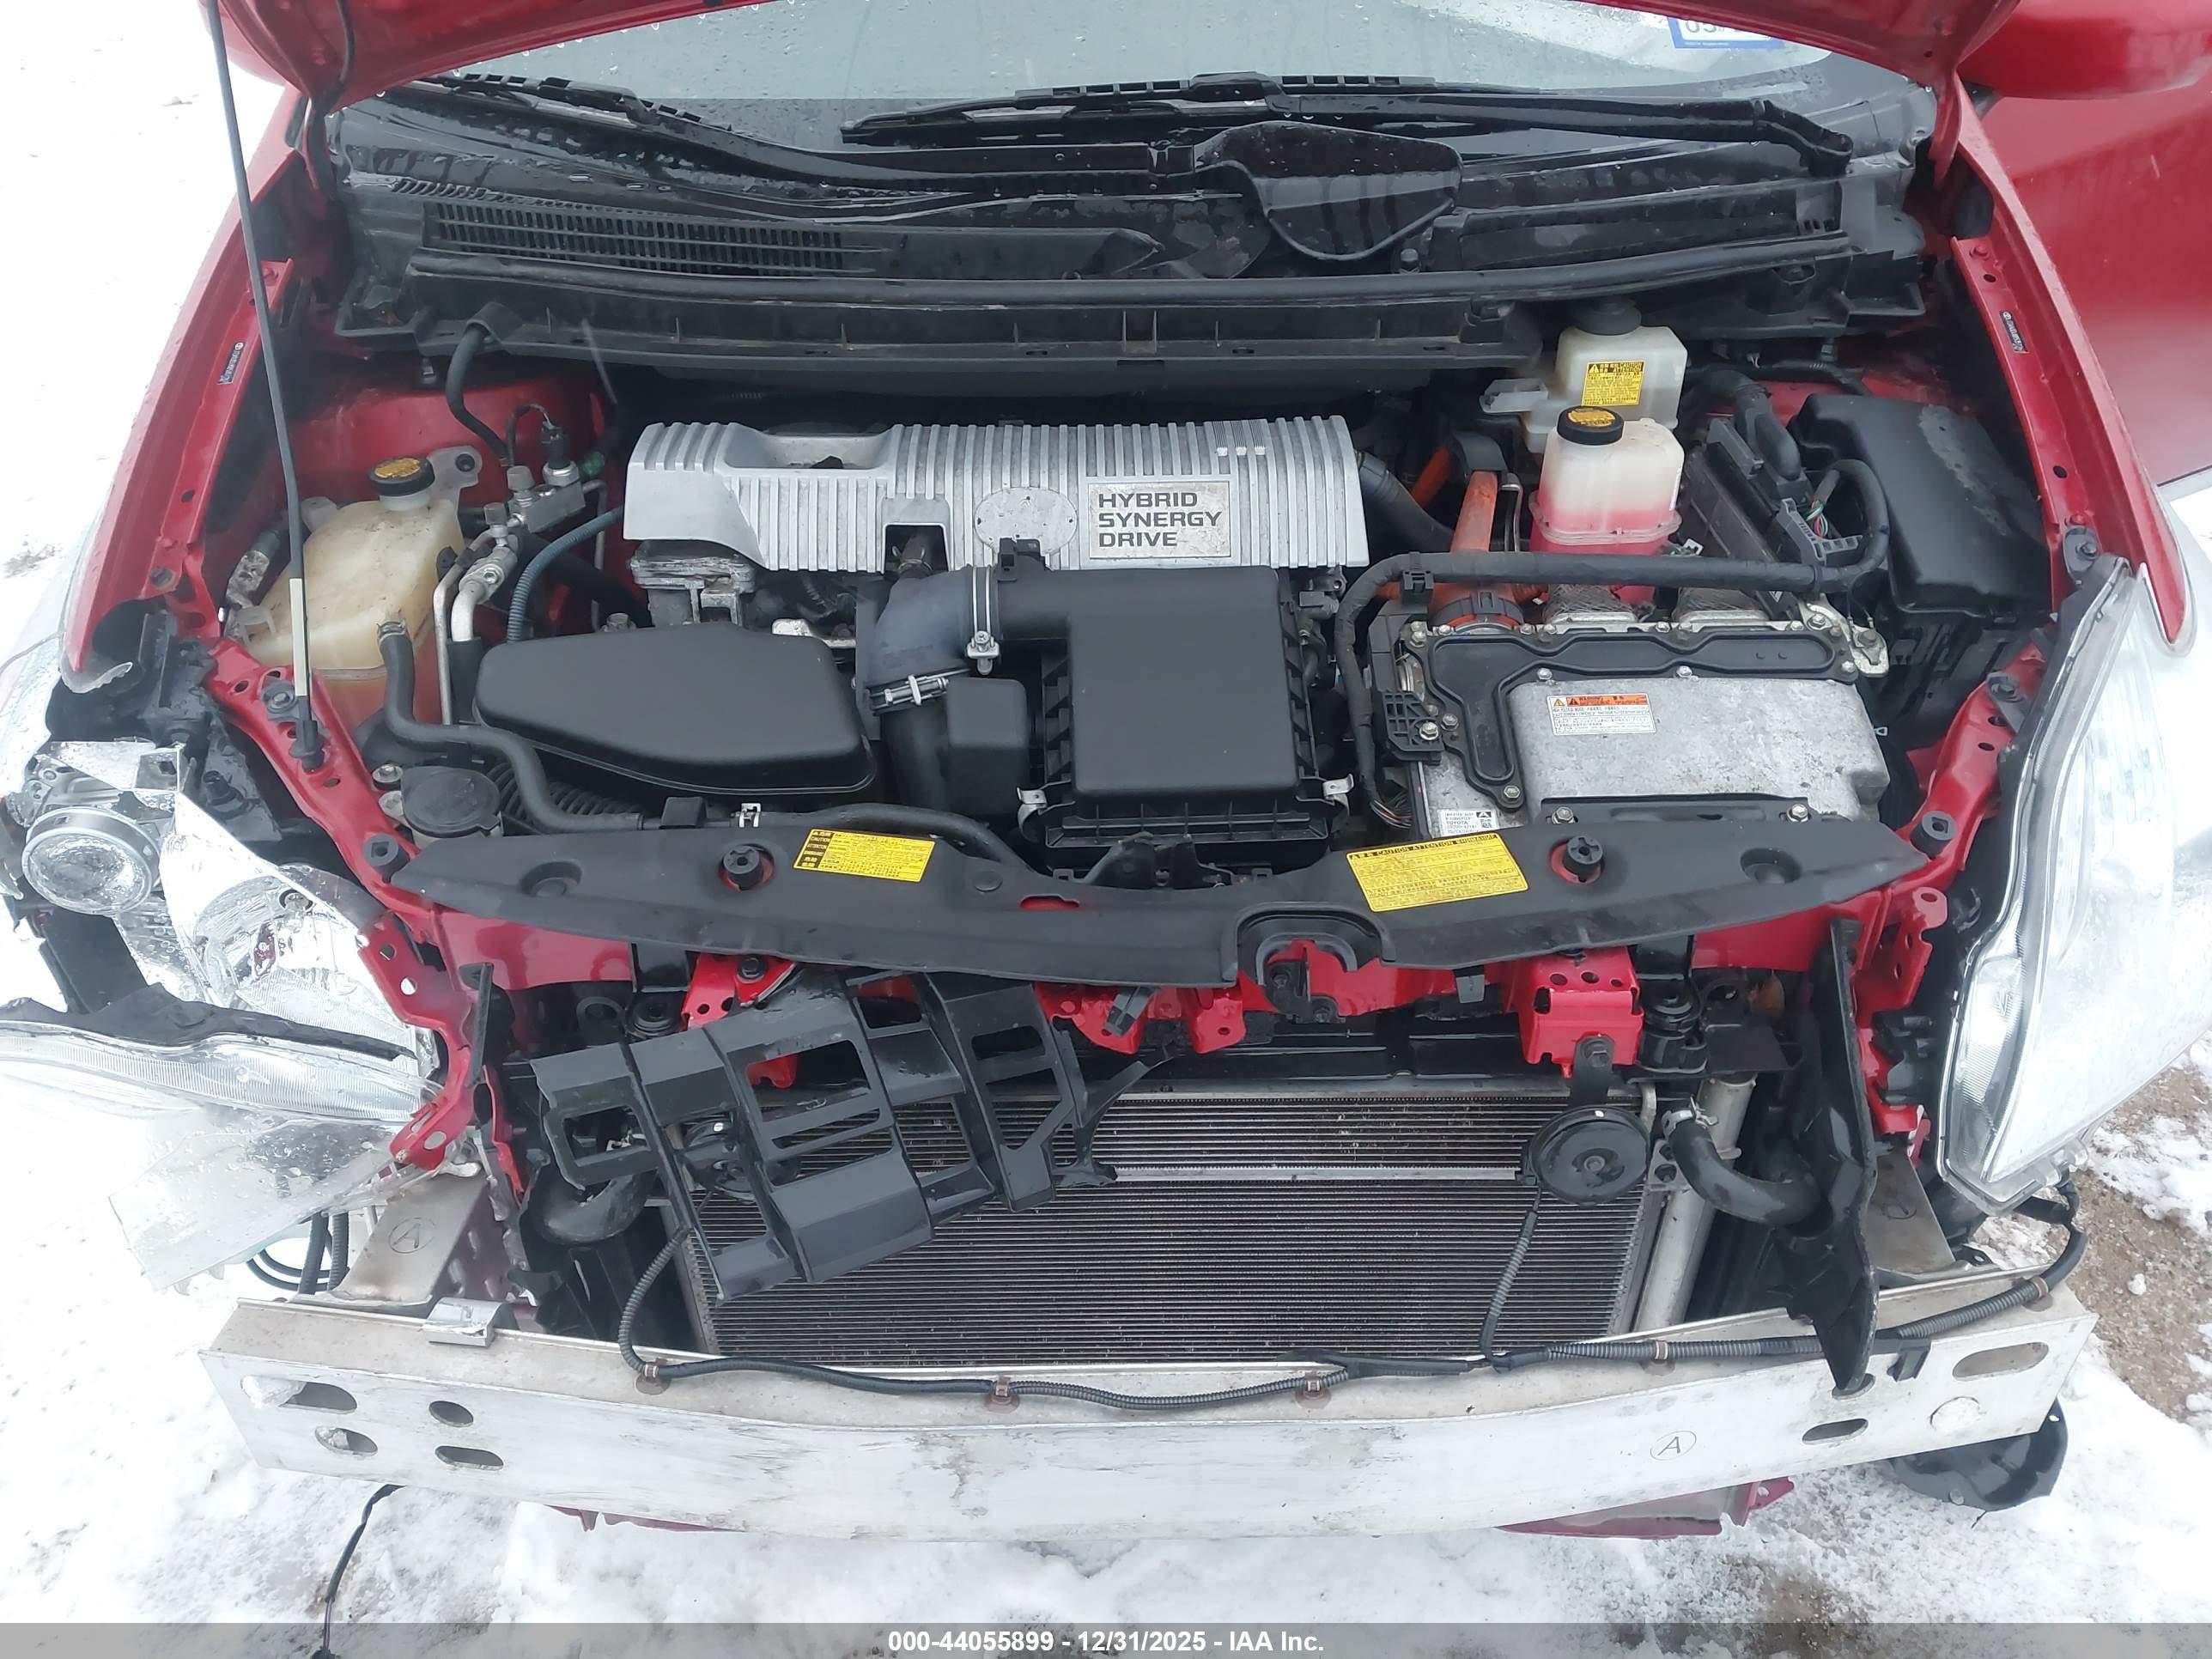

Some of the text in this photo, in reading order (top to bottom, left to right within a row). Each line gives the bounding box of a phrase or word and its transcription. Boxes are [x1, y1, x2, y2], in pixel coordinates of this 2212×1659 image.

[1098, 492, 1198, 508] HYBRID
[1098, 511, 1223, 528] SYNERGY
[1098, 532, 1178, 548] DRIVE
[1378, 847, 1408, 855] CAUTION
[1413, 841, 1453, 850] ATTENTION
